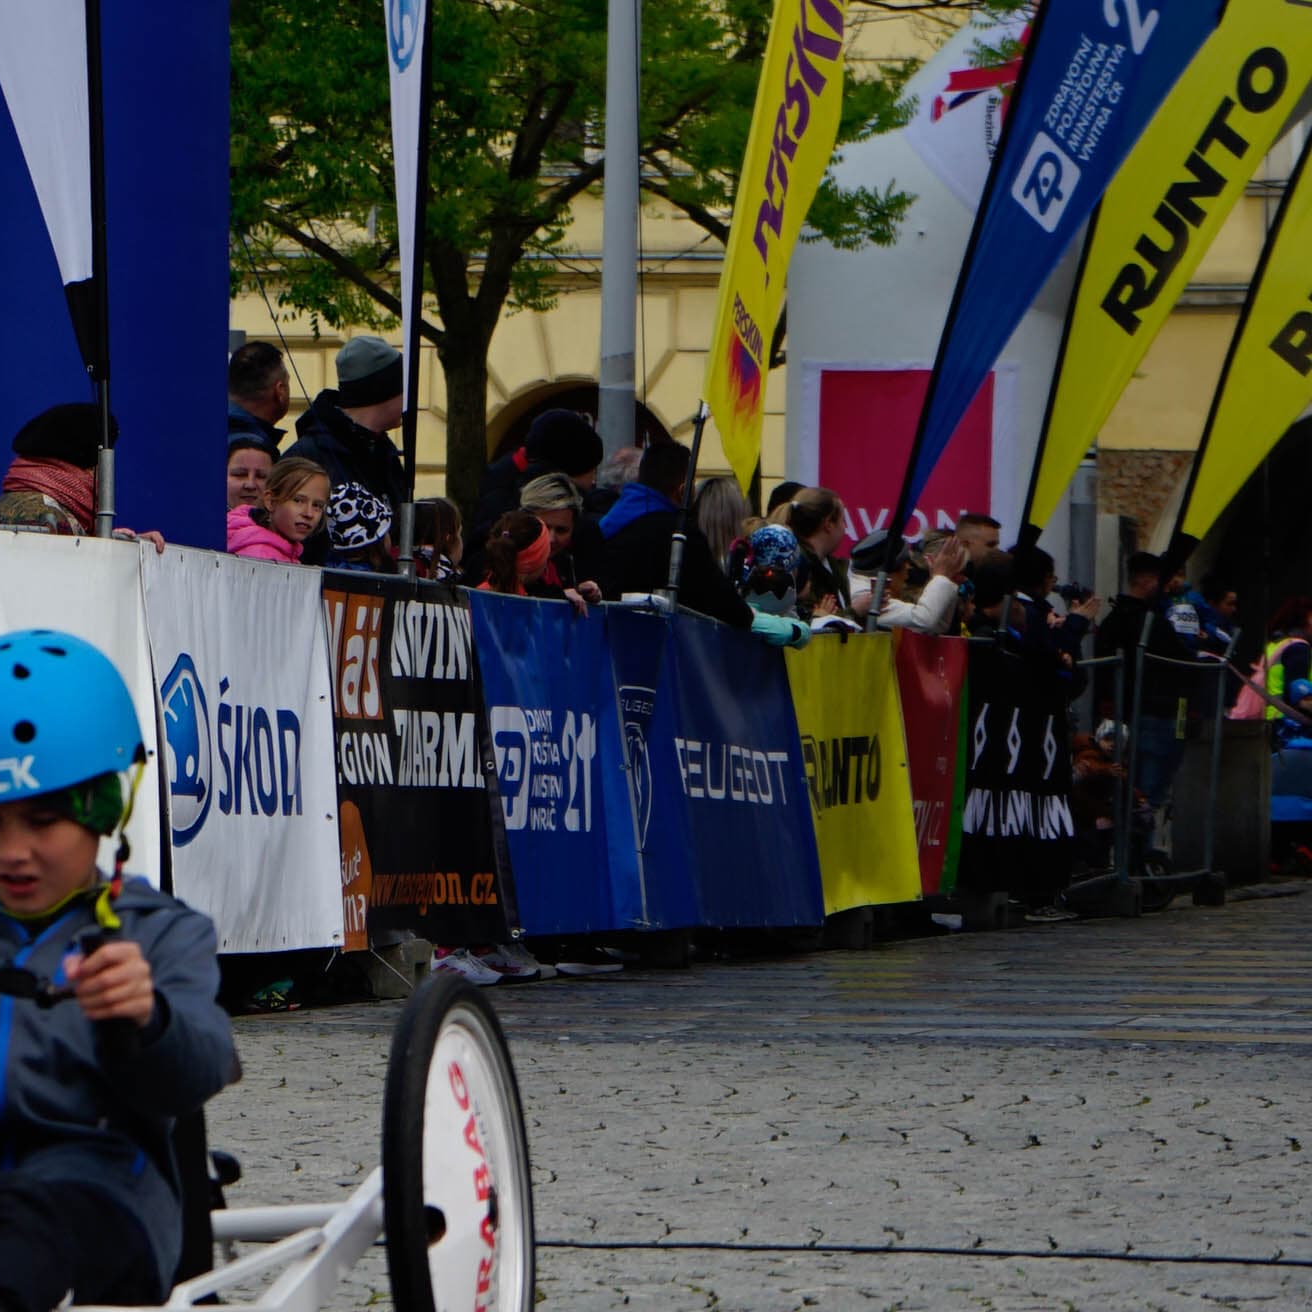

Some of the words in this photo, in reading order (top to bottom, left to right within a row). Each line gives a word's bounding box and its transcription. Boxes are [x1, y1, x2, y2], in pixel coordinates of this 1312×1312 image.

[1043, 32, 1094, 130] ZDRAVOTNÍ
[1055, 42, 1110, 140] POJIŠŤOVNA
[1067, 43, 1127, 153] MINISTERSTVA
[1078, 106, 1113, 162] VNITRA
[1107, 80, 1125, 106] ČR
[1101, 45, 1289, 336] RUNTO
[337, 731, 394, 785] GION
[392, 708, 486, 789] ZARM
[814, 735, 881, 812] UNTO
